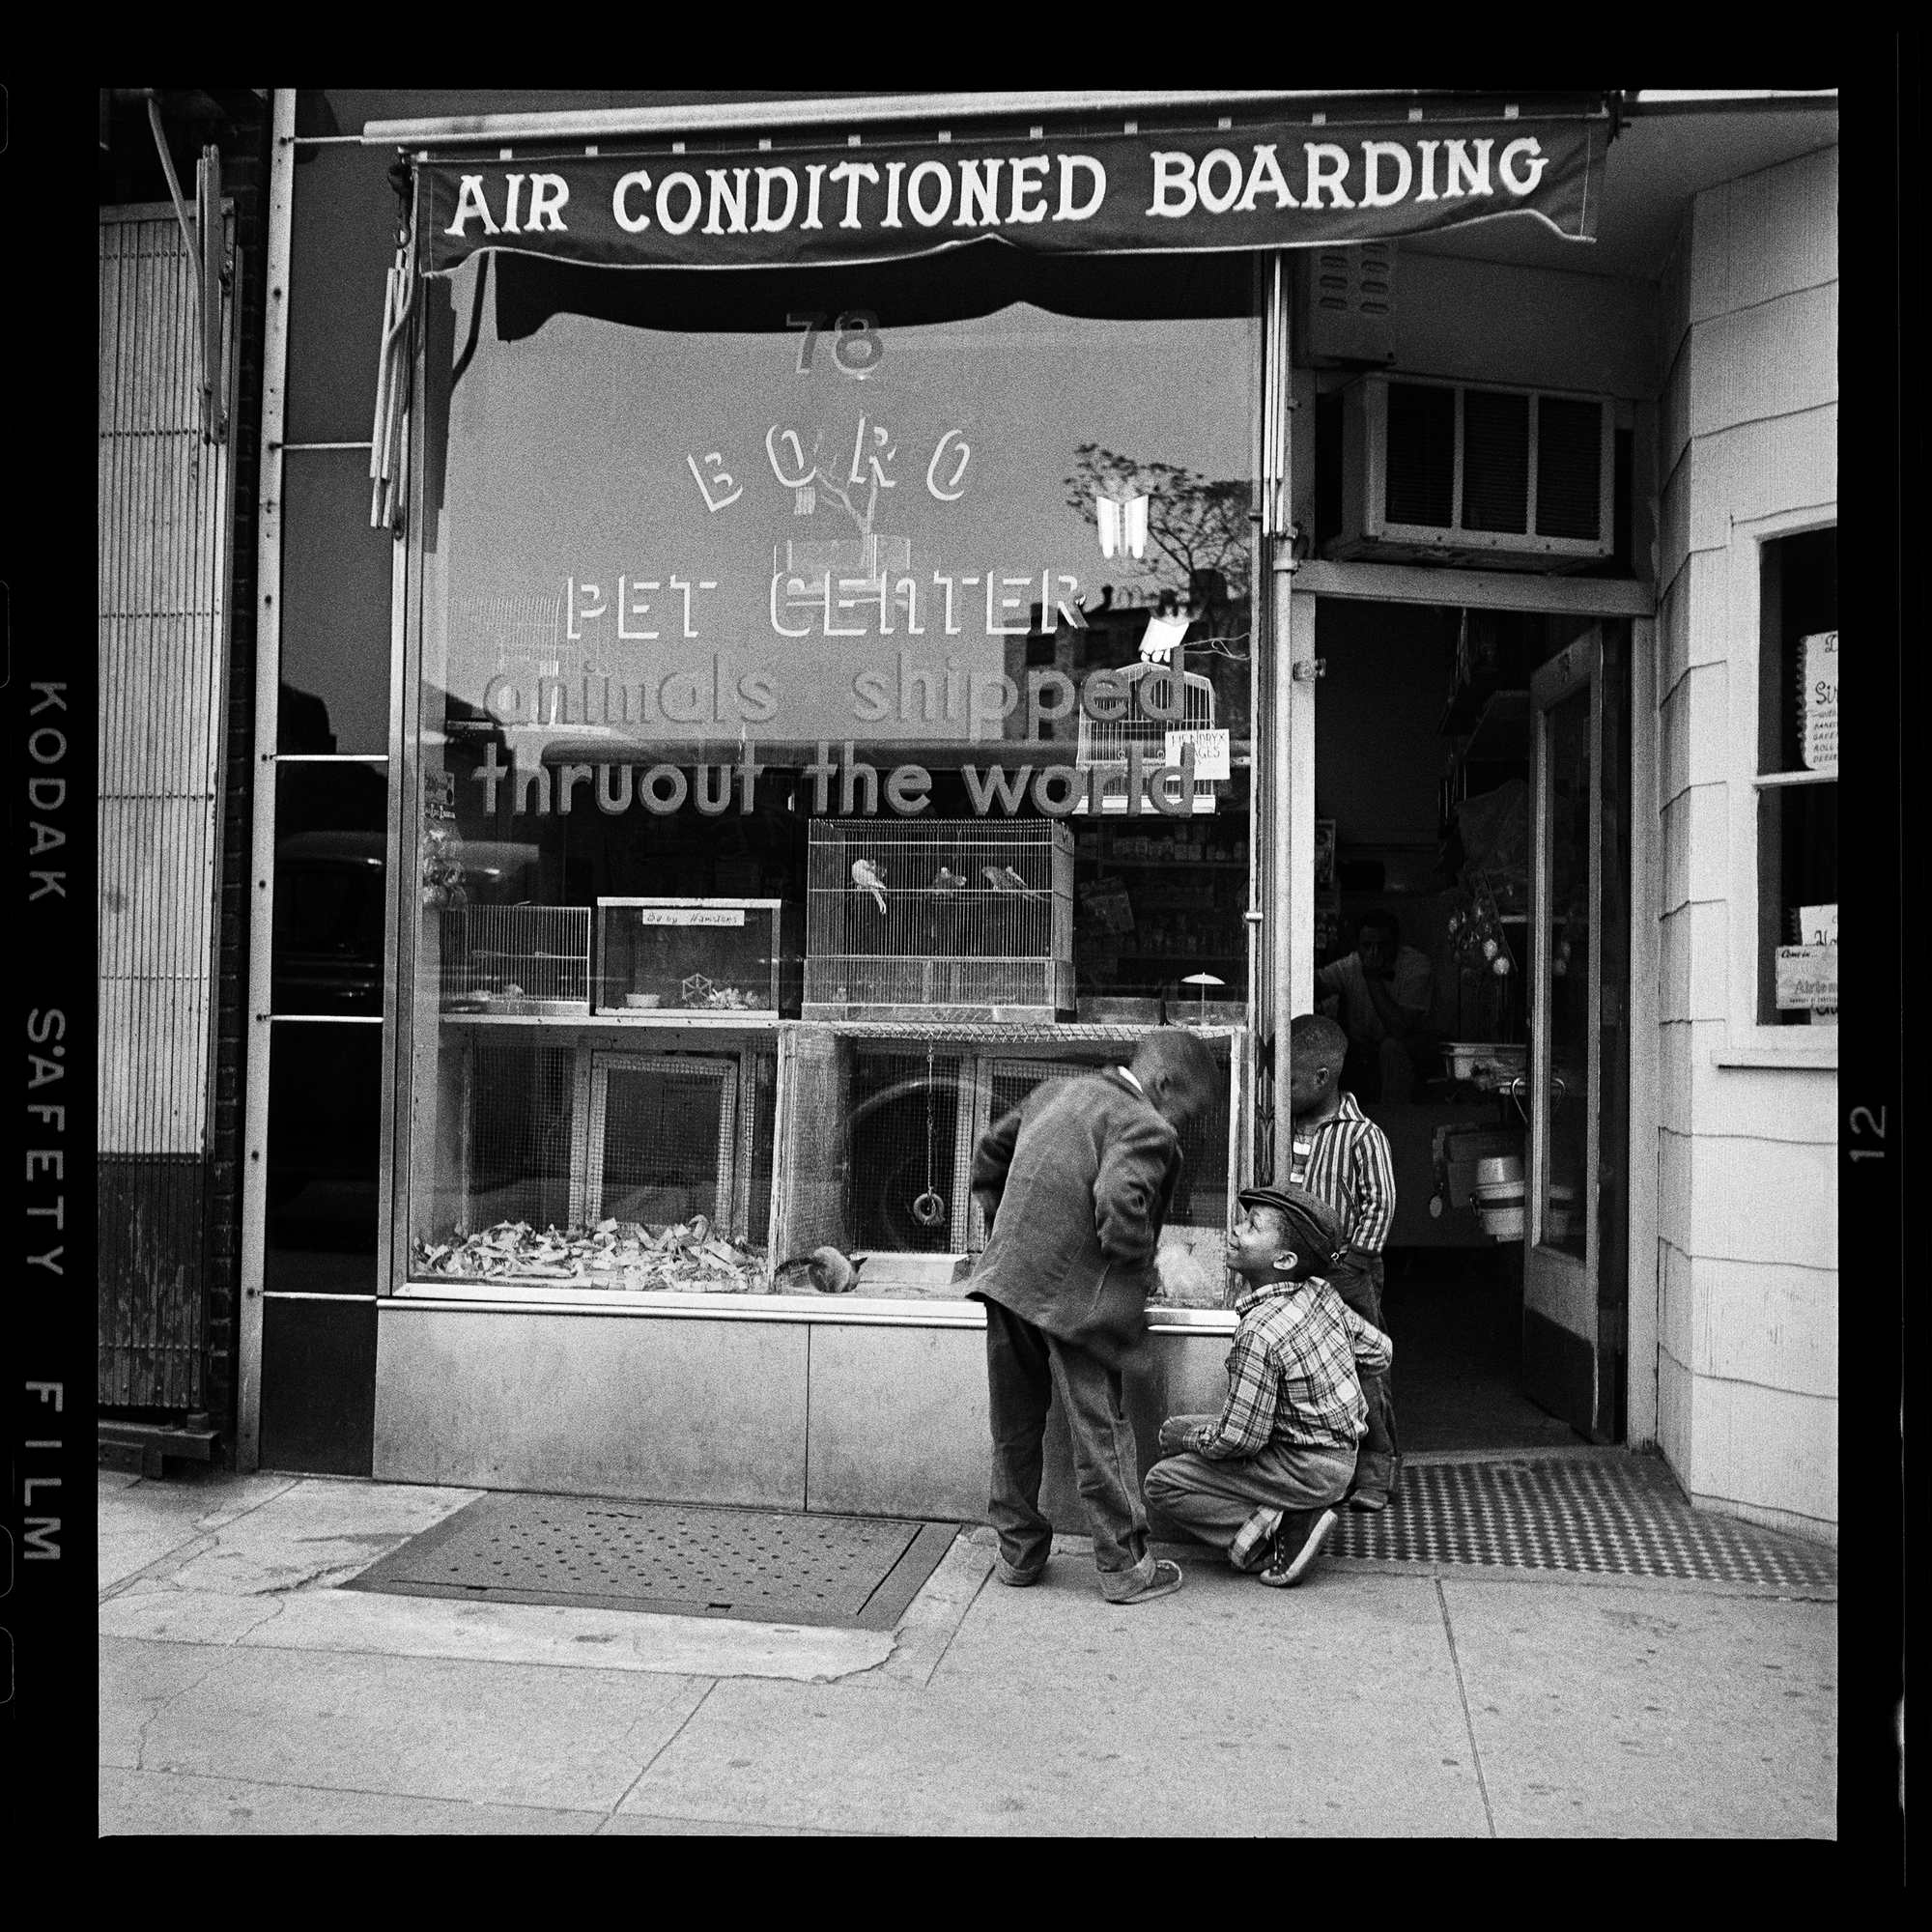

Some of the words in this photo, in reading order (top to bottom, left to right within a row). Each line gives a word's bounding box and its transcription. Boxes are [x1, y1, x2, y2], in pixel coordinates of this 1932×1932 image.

[444, 173, 570, 237] AIR
[612, 153, 1108, 236] CONDITIONED
[1146, 136, 1549, 218] BOARDING
[785, 310, 885, 378] 78
[687, 417, 971, 513] BORO
[566, 574, 718, 639] PET
[770, 568, 1092, 639] CENTER
[483, 652, 779, 724] animals
[852, 645, 1185, 745] shipped
[470, 739, 765, 817] thruout
[802, 740, 932, 817] the
[961, 740, 1195, 818] world
